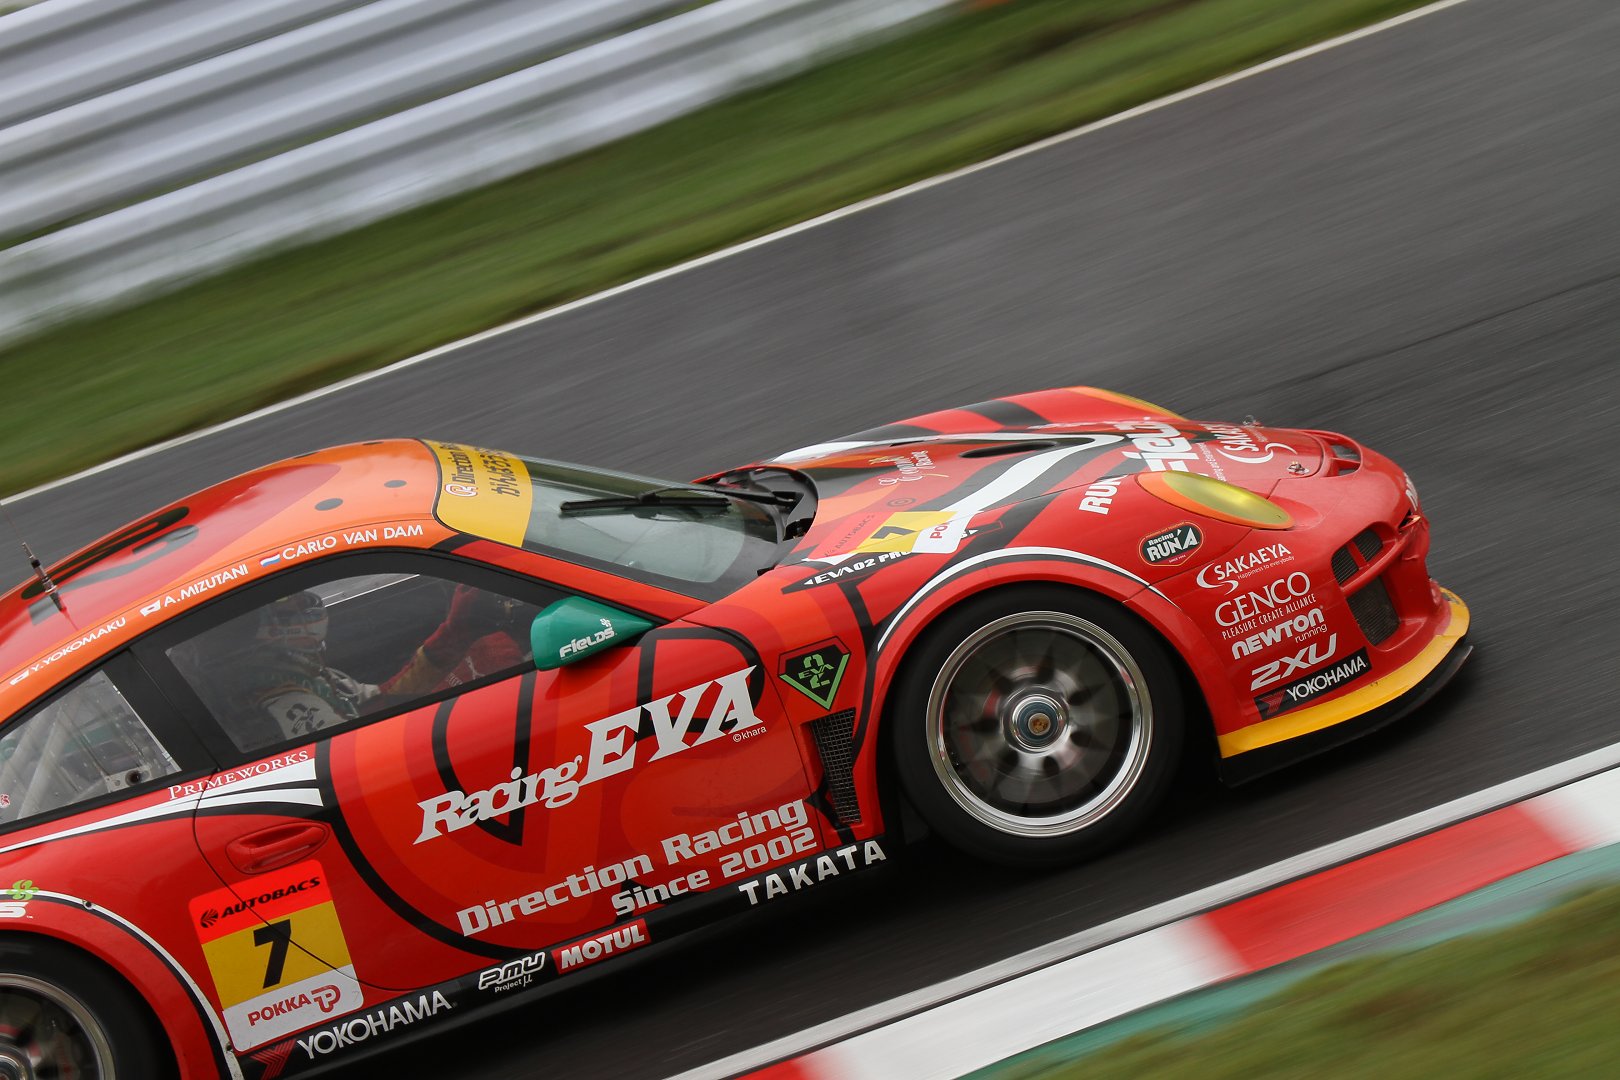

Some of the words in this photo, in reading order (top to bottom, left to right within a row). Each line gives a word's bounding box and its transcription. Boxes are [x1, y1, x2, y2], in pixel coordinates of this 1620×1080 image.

[282, 536, 337, 561] CARLO
[343, 528, 378, 546] VAN
[383, 524, 423, 538] DAM
[1148, 532, 1174, 546] Racing
[1214, 543, 1291, 580] SAKAEYA
[163, 563, 249, 607] A.MIZUTANI
[1215, 571, 1311, 627] GENCO
[1222, 619, 1257, 640] PLEASURE
[1258, 607, 1284, 625] CREATE
[1286, 593, 1317, 614] ALLIANCE
[1294, 623, 1328, 644] running
[30, 617, 126, 672] Y.YOKOMAKU
[1250, 633, 1337, 691] 2XU
[1286, 656, 1367, 701] YOKOHAMA
[168, 750, 310, 800] PRIMEWORKS
[413, 754, 584, 845] Racing
[579, 665, 763, 785] EVA
[456, 853, 655, 938] Direction
[660, 799, 809, 866] Racing
[611, 870, 711, 916] Since
[718, 827, 819, 878] 2002
[738, 840, 888, 906] TAKATA
[221, 876, 321, 919] AUTOBACS
[253, 918, 292, 989] 7
[561, 924, 646, 970] MOTUL
[247, 993, 313, 1026] POKKA
[494, 979, 523, 993] Project
[297, 990, 453, 1060] YOKOHAMA
